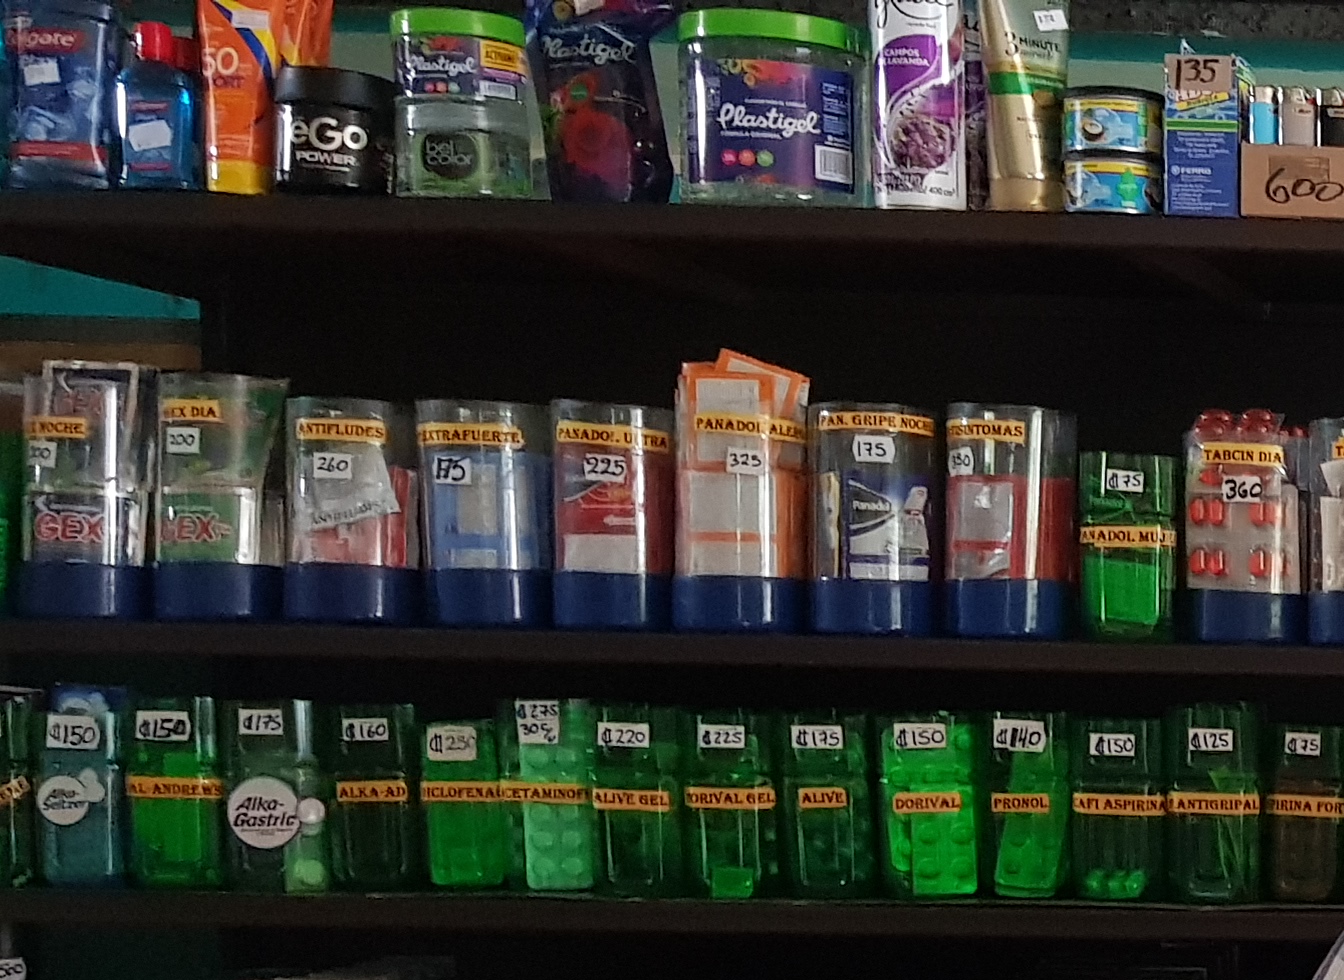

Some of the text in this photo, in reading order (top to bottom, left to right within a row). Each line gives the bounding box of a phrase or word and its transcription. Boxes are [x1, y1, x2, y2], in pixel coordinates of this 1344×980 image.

[542, 34, 638, 65] Plastigel
[1174, 58, 1219, 93] 135
[717, 102, 822, 138] Plastigel
[290, 117, 368, 151] eGo
[1265, 167, 1344, 204] 600
[853, 413, 897, 428] GRIPE
[624, 432, 667, 448] UTRA
[856, 441, 888, 457] 175
[1204, 449, 1283, 463] TABCIN DIA
[316, 456, 349, 473] 260
[586, 457, 626, 476] 225
[729, 452, 762, 468] 325
[1224, 478, 1263, 500] 360
[339, 785, 406, 798] ALKA-AD
[746, 793, 775, 806] GEL
[802, 791, 845, 804] ALIVE
[235, 796, 284, 811] Alka-
[638, 793, 669, 807] GEL
[895, 796, 961, 810] DORIVAL
[993, 796, 1048, 810] PRONOL
[1176, 797, 1259, 812] ANTIGRIPAL
[233, 810, 296, 828] Gastric
